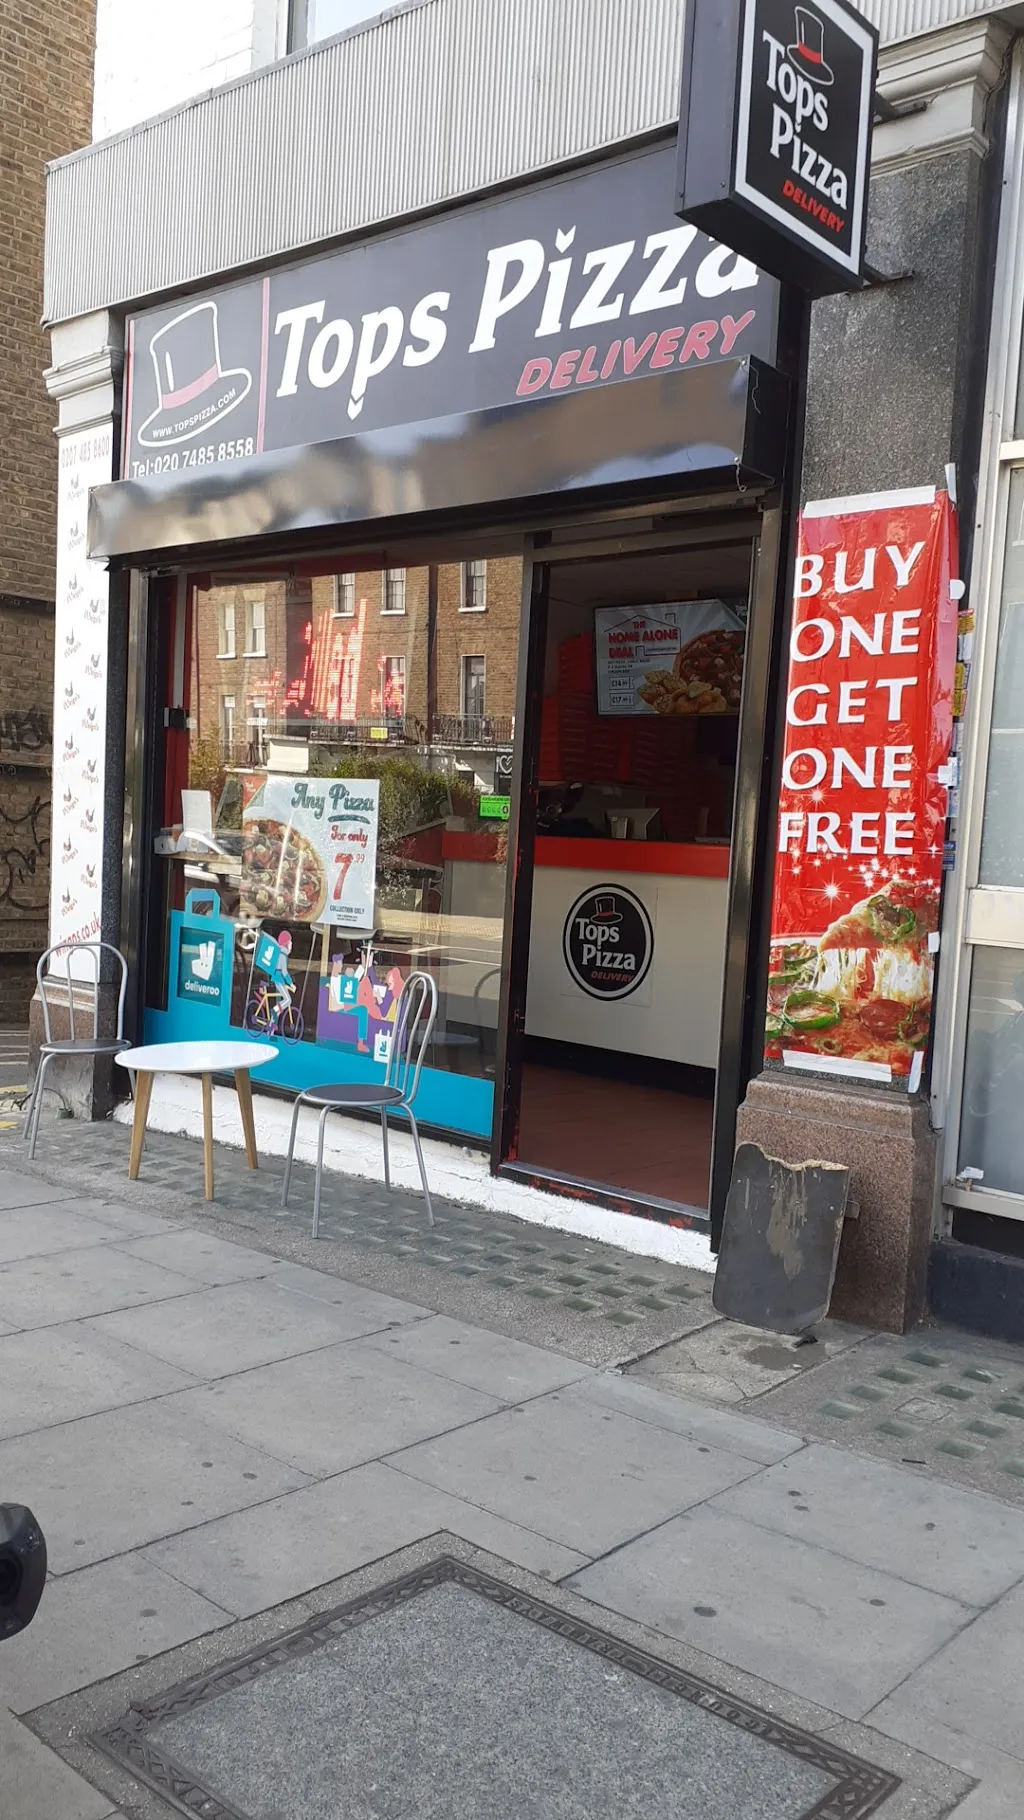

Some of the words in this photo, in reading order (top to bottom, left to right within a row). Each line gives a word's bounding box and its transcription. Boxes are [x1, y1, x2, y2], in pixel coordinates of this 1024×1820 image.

[763, 30, 828, 131] Tops
[770, 103, 848, 209] Pizza
[783, 180, 845, 233] DELIVERY
[274, 291, 450, 420] Tops
[468, 224, 759, 353] Pizza
[516, 310, 756, 396] DELIVERY
[152, 388, 237, 438] WWW.TOPSPIZZA.COM
[182, 445, 215, 468] 7485
[218, 437, 254, 461] 8558
[792, 541, 926, 598] BUY
[789, 608, 922, 662] ONE
[786, 676, 918, 726] GET
[781, 744, 914, 790] ONE
[291, 783, 326, 819] Any
[328, 783, 375, 812] Pizza
[778, 811, 916, 855] FREE
[575, 918, 620, 949] Tops
[582, 943, 636, 970] Pizza
[184, 980, 220, 996] deliveroo
[591, 970, 635, 982] DELIVERY
